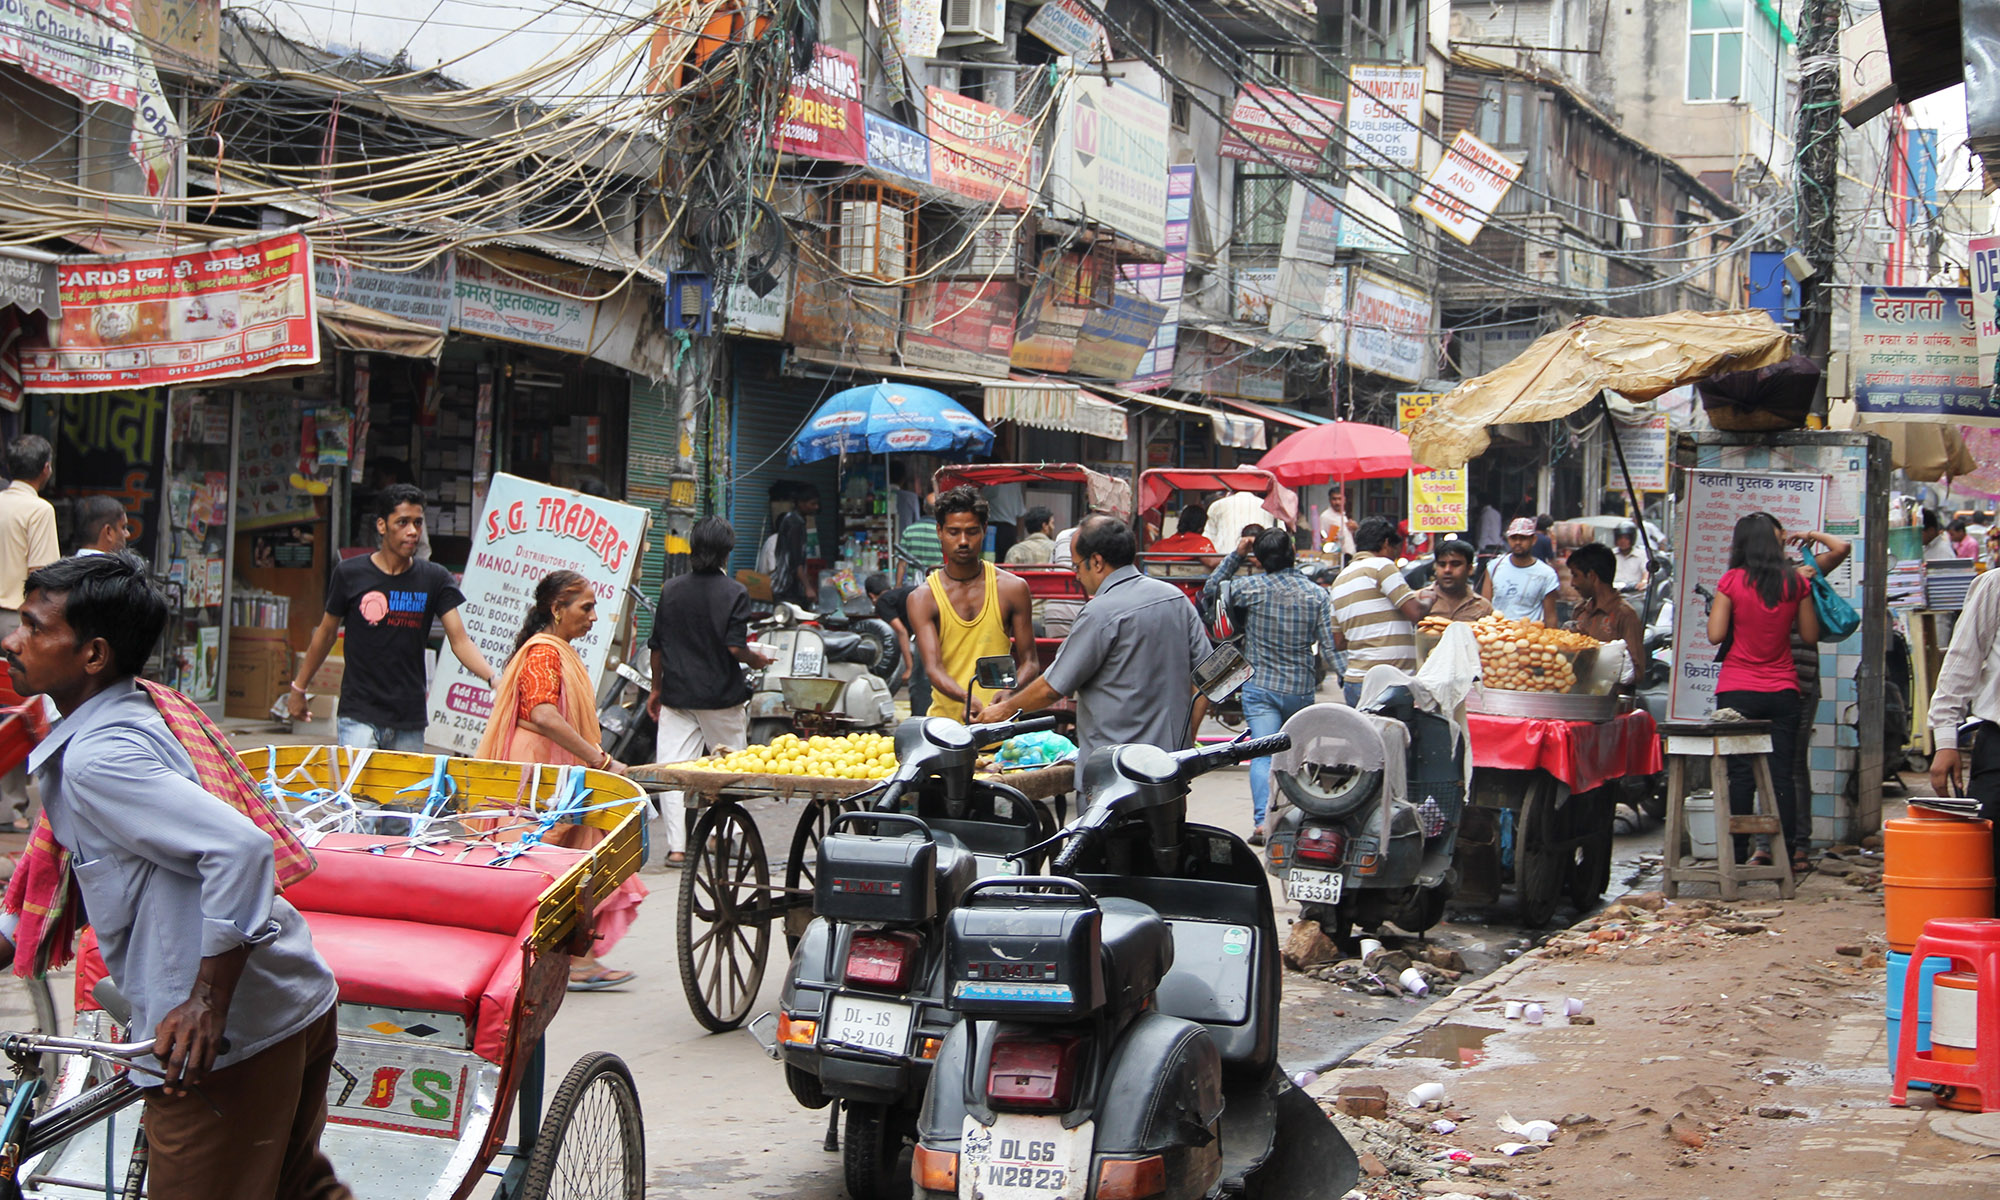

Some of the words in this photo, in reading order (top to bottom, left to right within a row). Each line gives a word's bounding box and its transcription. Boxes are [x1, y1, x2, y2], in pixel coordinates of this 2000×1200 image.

[1352, 79, 1400, 99] DHANPAT
[1401, 81, 1420, 99] RAI
[1349, 120, 1417, 132] PUBLISHERS
[1366, 134, 1402, 143] BOOK
[1447, 171, 1476, 193] AND
[454, 281, 493, 306] कमल
[494, 289, 562, 318] पुस्तकालय
[1871, 287, 1945, 324] देहाती
[1863, 334, 1875, 346] हर
[1420, 470, 1459, 480] C.B.S.E.
[1423, 483, 1456, 493] School
[1698, 473, 1733, 488] देहाती
[1736, 476, 1774, 493] पुस्तक
[1778, 479, 1815, 492] भण्डार
[1416, 503, 1463, 514] COLLEGE
[1421, 516, 1458, 526] BOOKS
[536, 497, 630, 573] TRADERS
[475, 552, 519, 577] MANOJ
[400, 591, 413, 601] ALL
[414, 591, 428, 602] YOU
[484, 591, 521, 612] CHARTS,
[388, 600, 427, 613] VIRGINS
[465, 602, 485, 617] EDU.
[467, 619, 487, 634] COL.
[452, 684, 472, 698] Add
[452, 696, 470, 711] Nai
[433, 709, 450, 725] Ph.
[452, 733, 466, 748] M.
[844, 880, 890, 895] LML
[982, 963, 1044, 979] LML
[844, 1007, 865, 1024] DL
[1000, 1139, 1056, 1162] DL6S
[989, 1167, 1064, 1191] W2823
